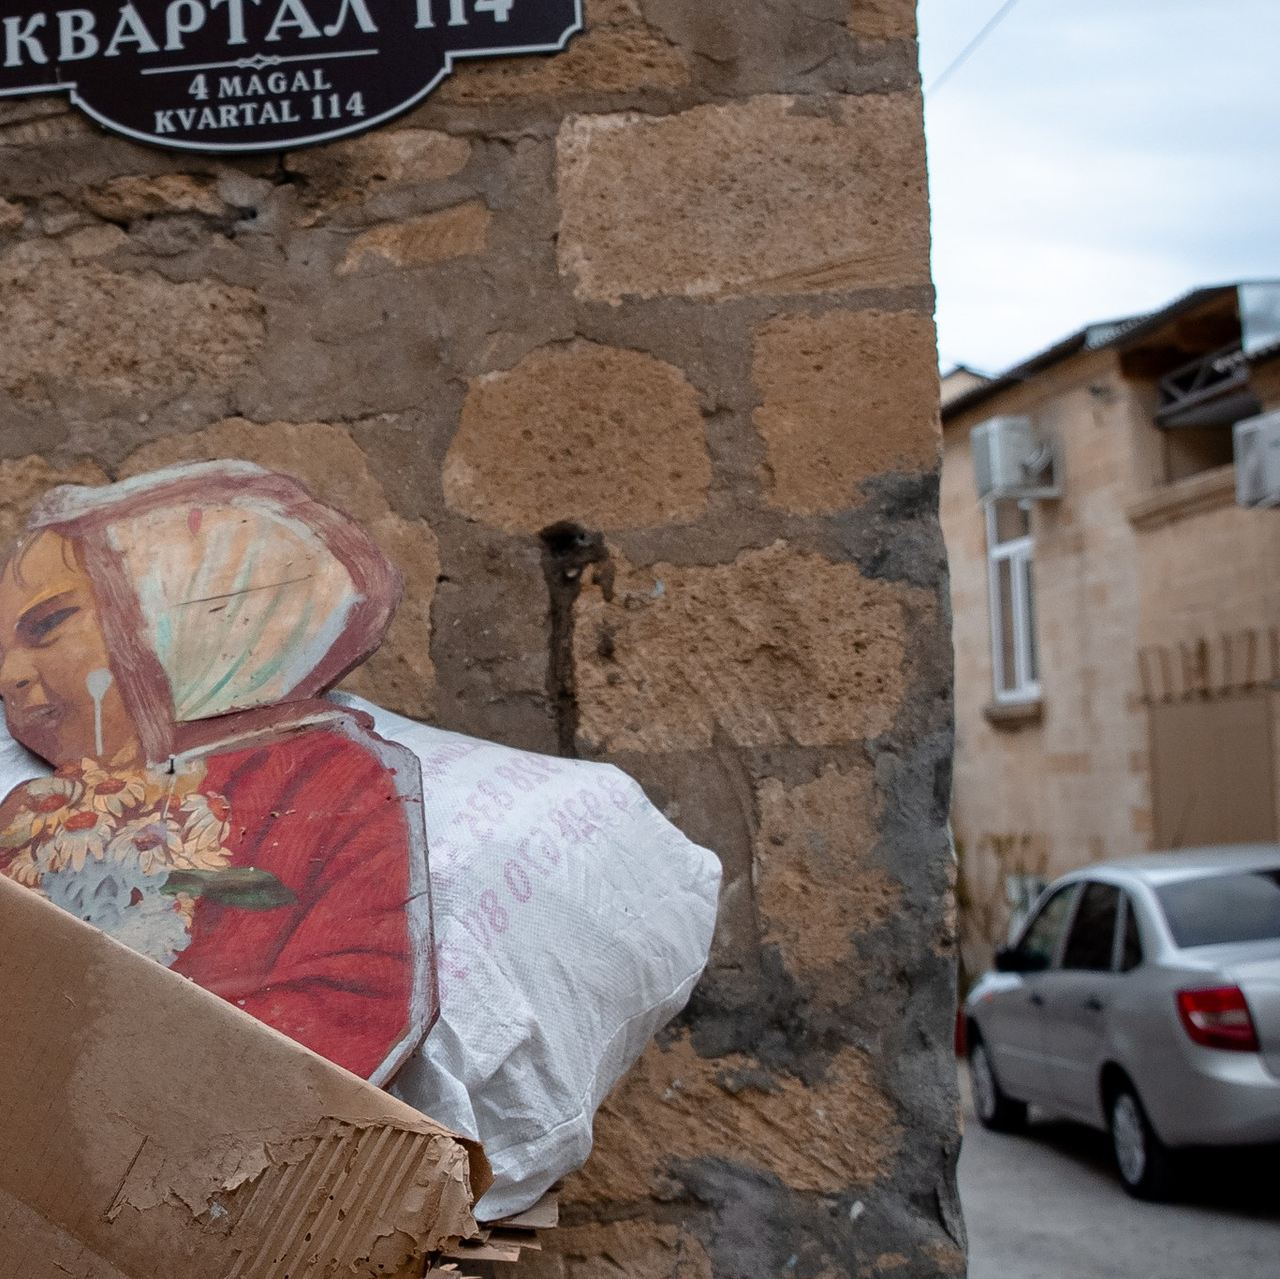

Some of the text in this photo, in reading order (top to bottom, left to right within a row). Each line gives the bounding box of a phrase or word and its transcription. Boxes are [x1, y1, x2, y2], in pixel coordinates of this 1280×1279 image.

[188, 70, 331, 100] 4 MAGAL
[154, 92, 364, 135] KVARTAL 114
